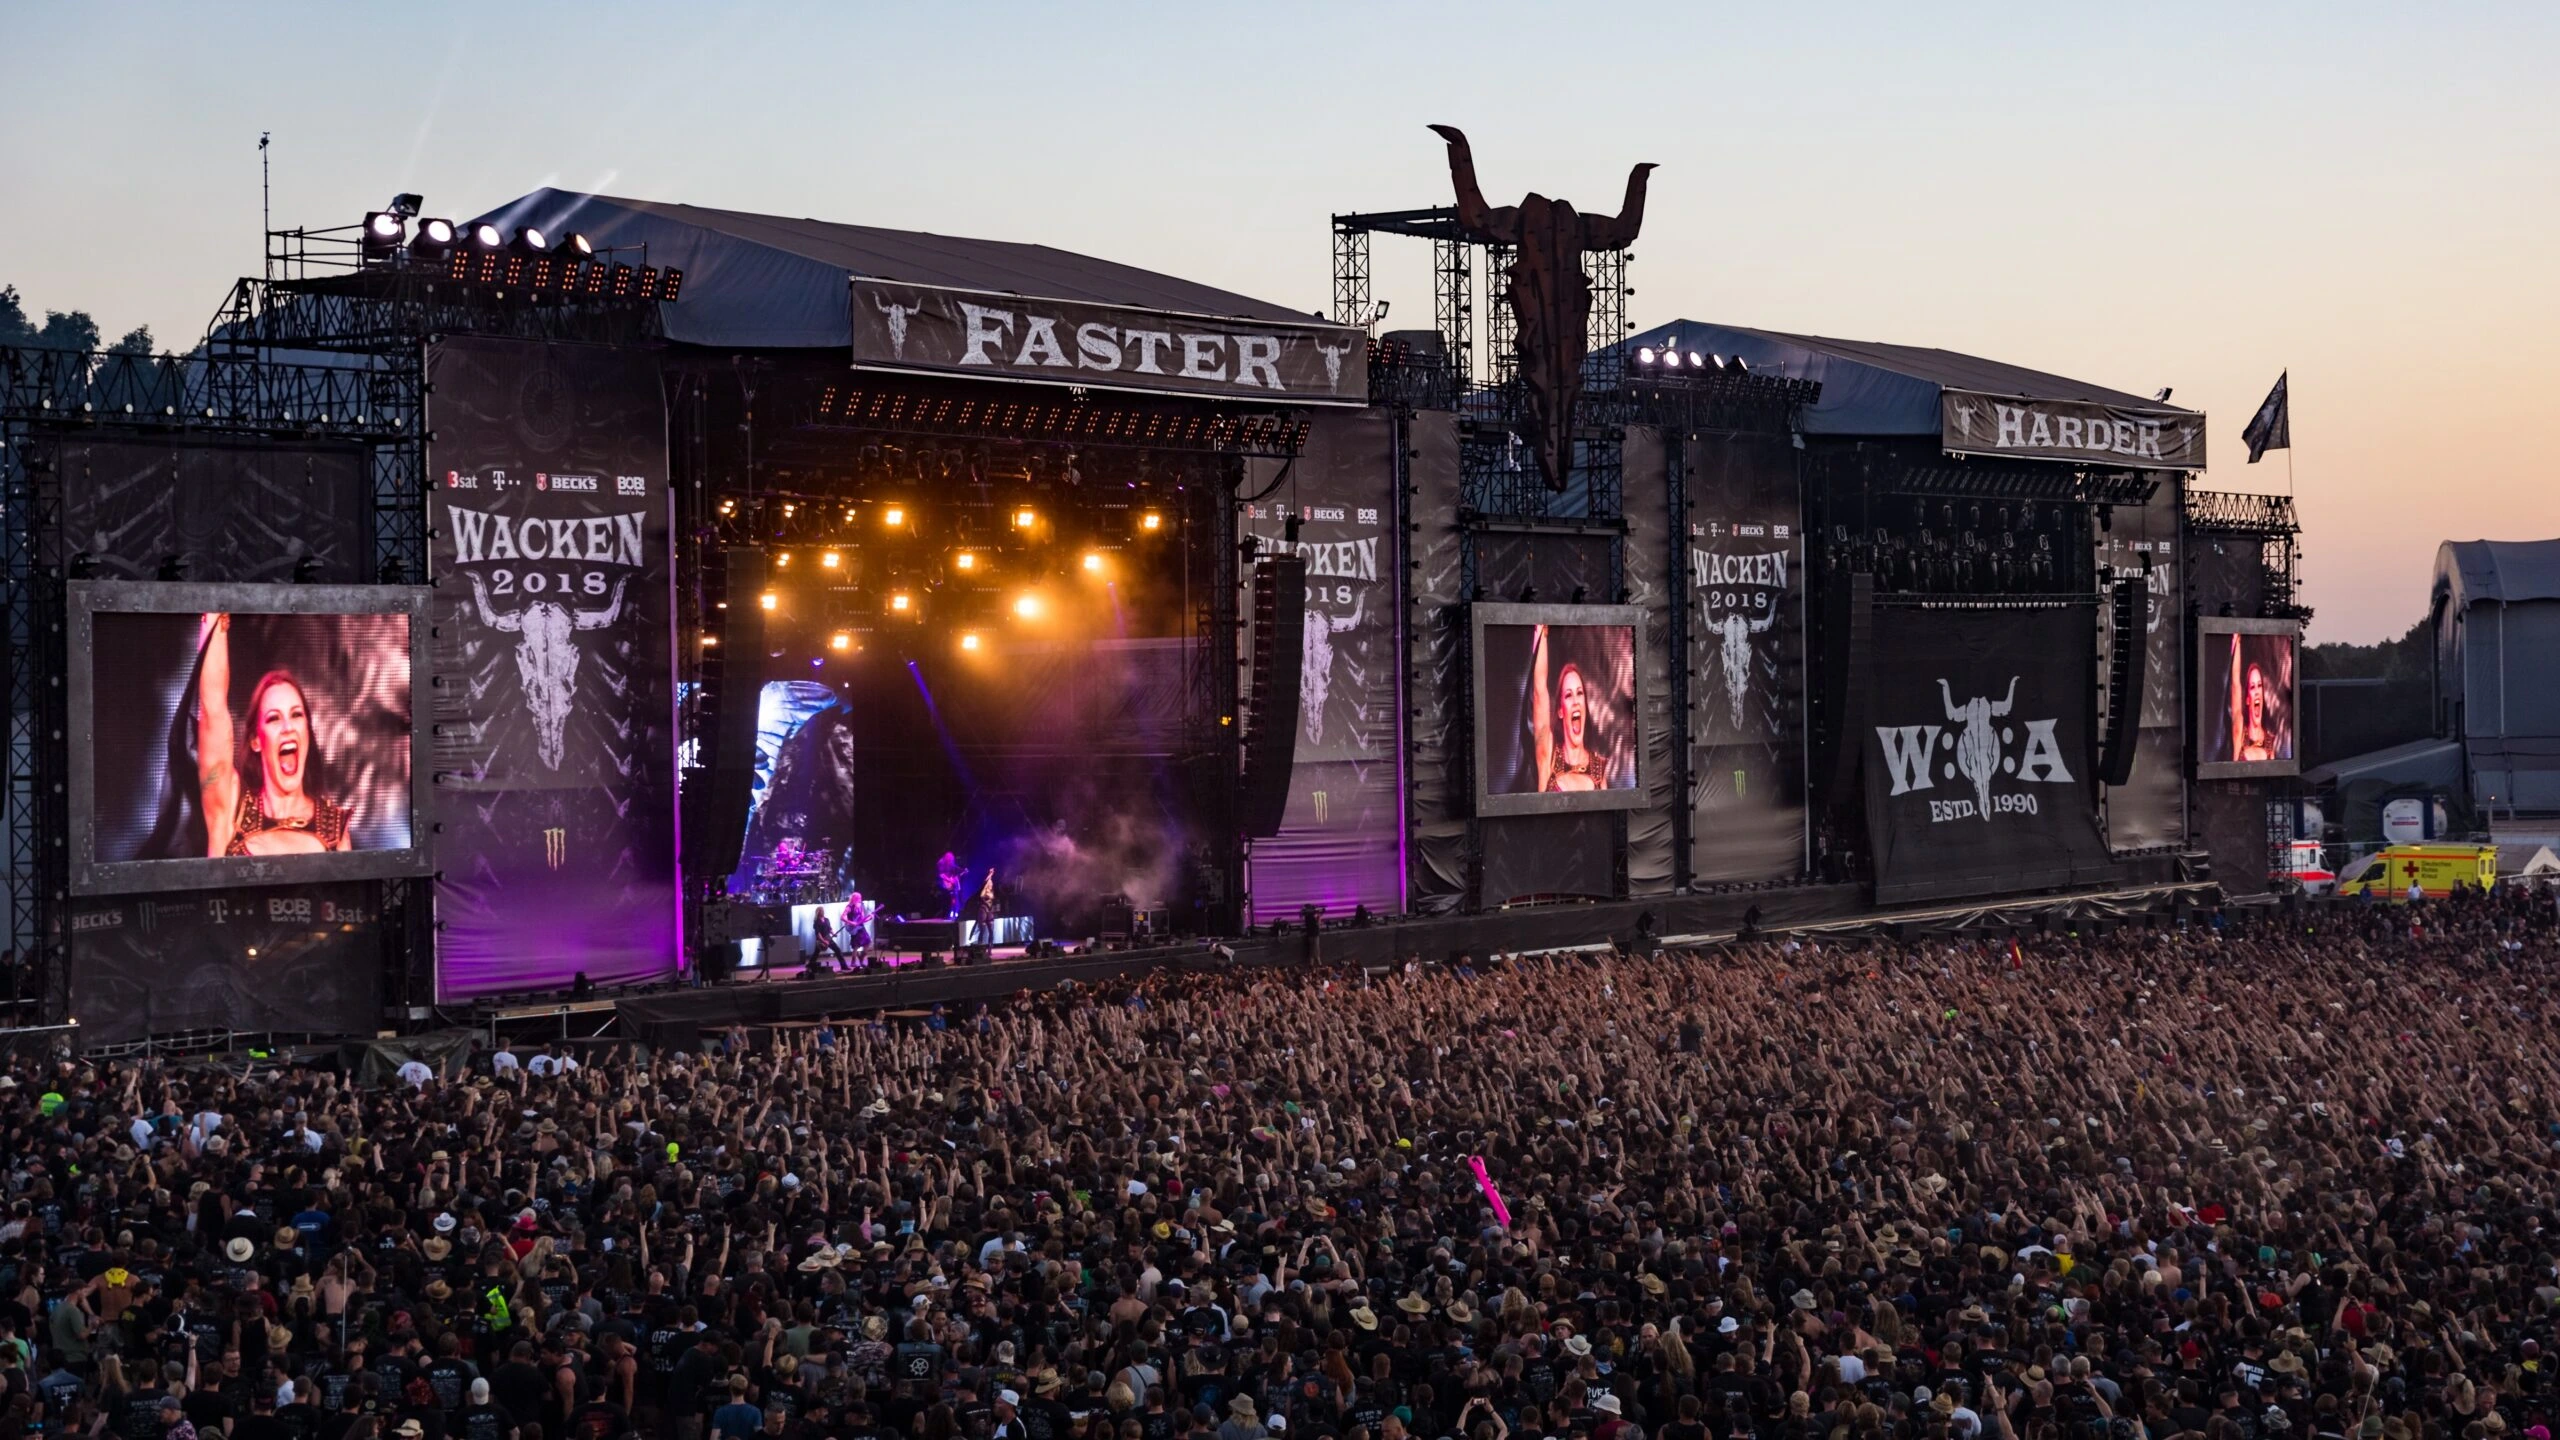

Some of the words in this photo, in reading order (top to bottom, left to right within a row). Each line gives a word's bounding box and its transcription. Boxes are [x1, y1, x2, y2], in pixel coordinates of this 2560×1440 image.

[957, 301, 1286, 392] FASTER
[1994, 403, 2164, 461] HARDER
[448, 471, 478, 489] 3sat
[551, 475, 598, 491] BECK'S
[617, 476, 646, 490] BOB!
[1314, 508, 1345, 520] BECK'S
[447, 504, 647, 568] WACKEN
[1740, 525, 1764, 536] BECK'S
[1692, 547, 1790, 589] WACKEN
[491, 569, 607, 595] 2018
[1711, 591, 1767, 609] 2018
[1929, 800, 1978, 823] ESTD.
[1993, 793, 2038, 816] 1990
[268, 898, 311, 916] BOB!
[322, 901, 364, 923] 3sat
[71, 910, 123, 930] BECK'S
